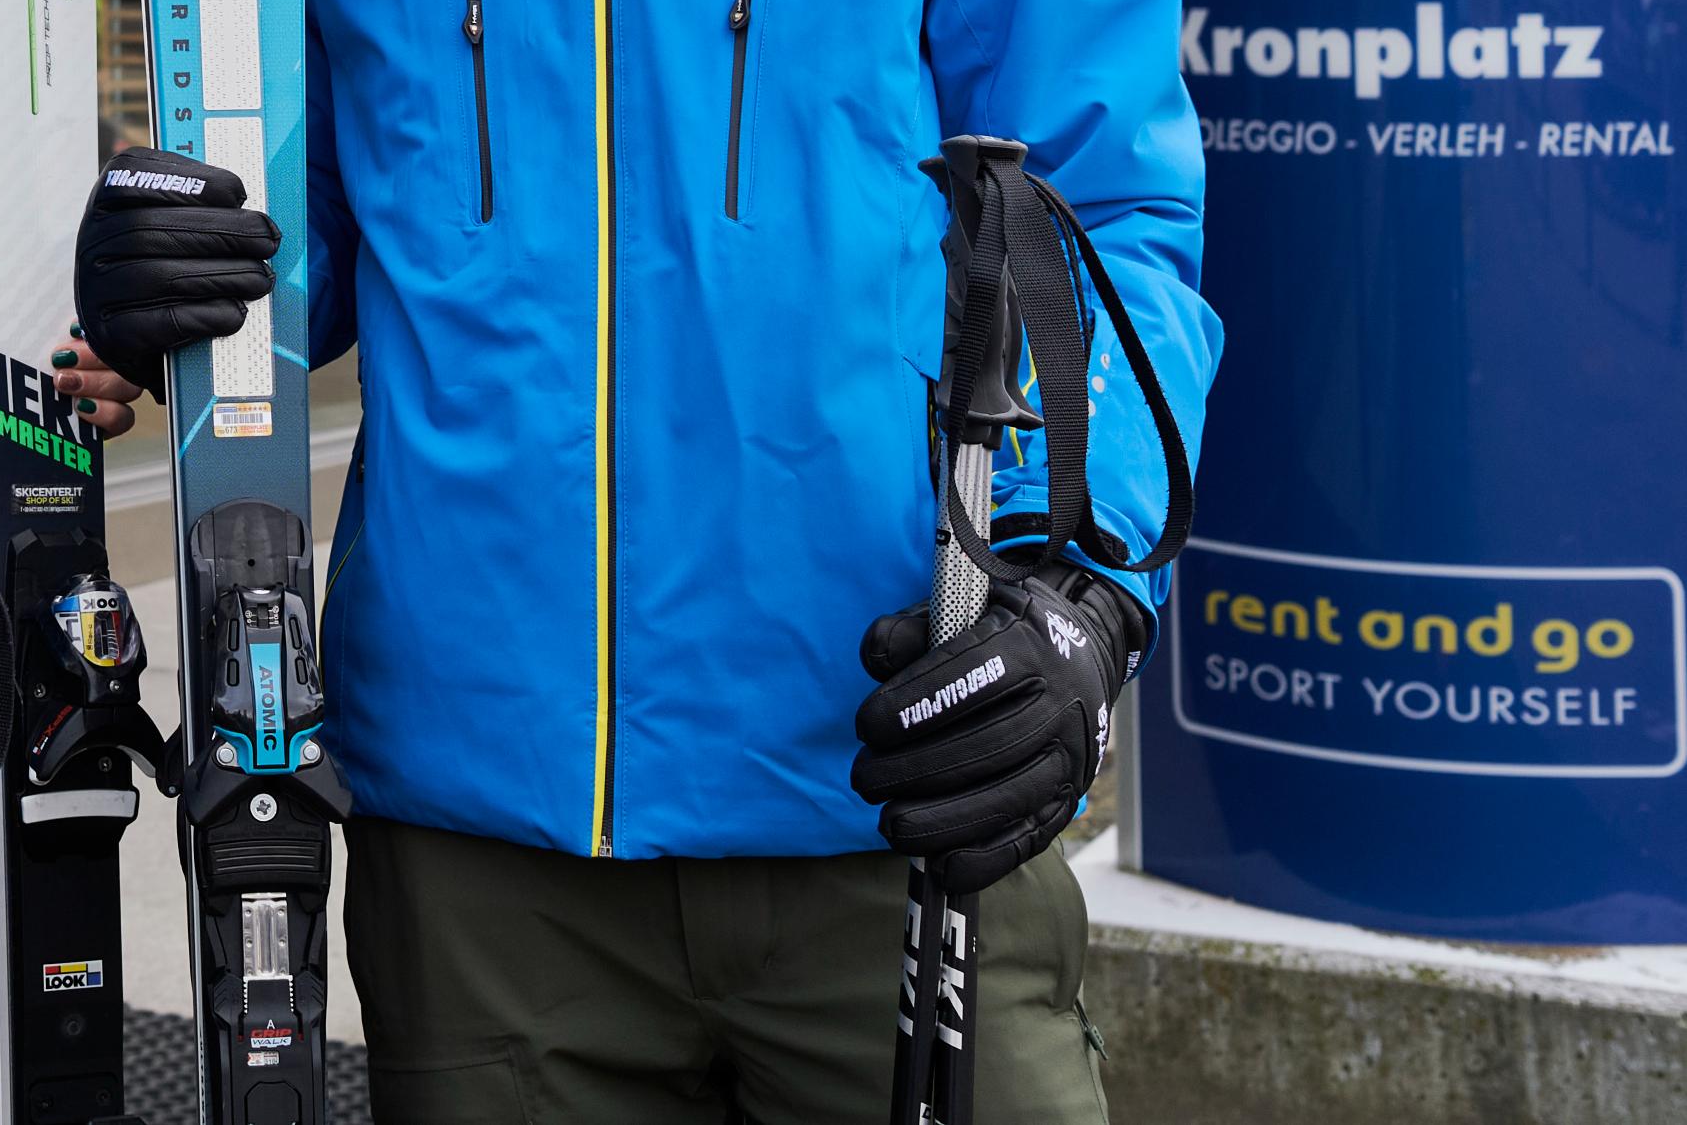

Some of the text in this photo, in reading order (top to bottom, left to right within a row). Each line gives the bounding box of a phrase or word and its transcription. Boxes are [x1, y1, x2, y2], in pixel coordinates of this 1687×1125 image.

[1179, 3, 1604, 99] Kronplatz
[1367, 124, 1505, 157] VERLEH
[1538, 124, 1675, 158] RENTAL
[15, 487, 83, 497] SKICENTER.IT
[1205, 590, 1634, 673] rent and go
[259, 665, 277, 751] ATOMIC
[899, 655, 1006, 729] ENERGIAPURA
[1205, 654, 1638, 726] SPORT YOURSELF
[45, 974, 86, 990] LOOK
[897, 857, 923, 1037] EKI
[252, 1028, 292, 1038] GRIP
[266, 1019, 275, 1029] A
